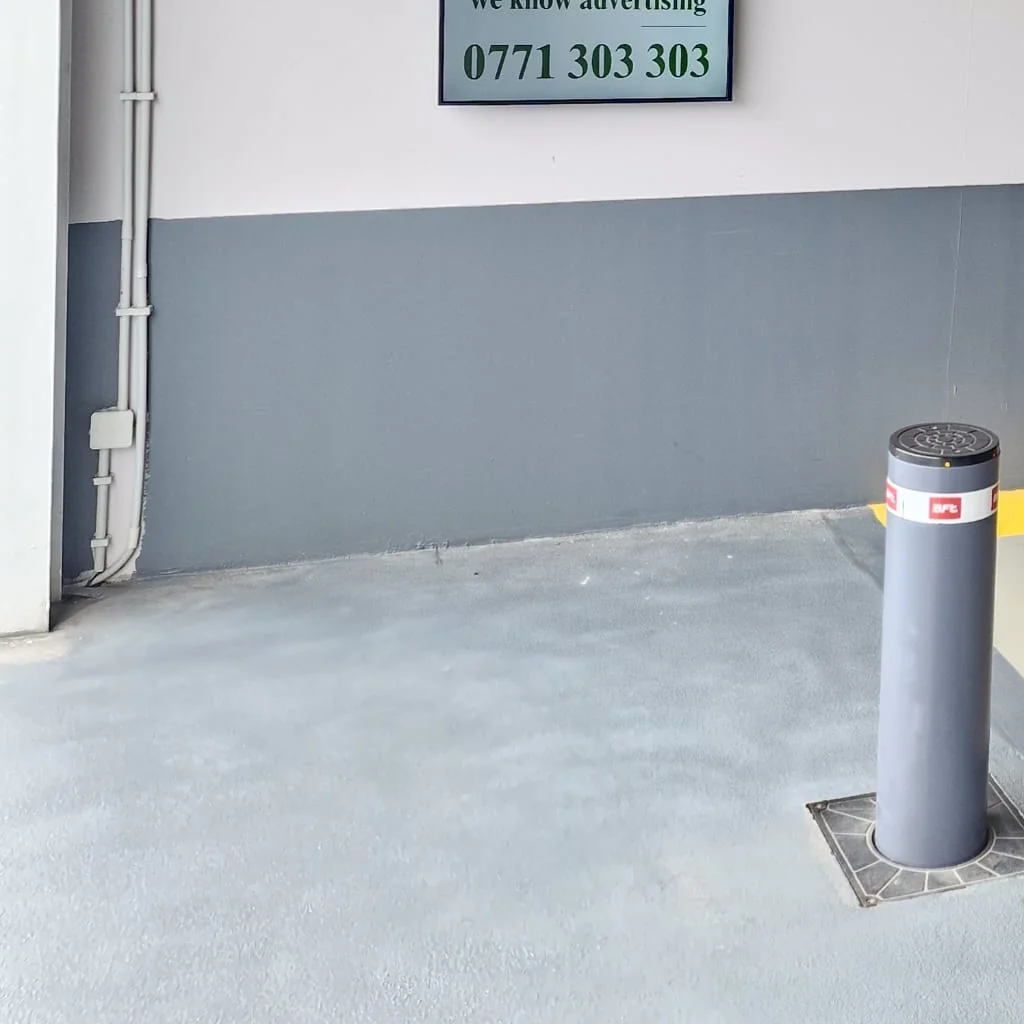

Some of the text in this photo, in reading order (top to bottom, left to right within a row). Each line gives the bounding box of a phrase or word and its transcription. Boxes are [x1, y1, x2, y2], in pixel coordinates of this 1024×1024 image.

[463, 43, 710, 81] 0771 303 303
